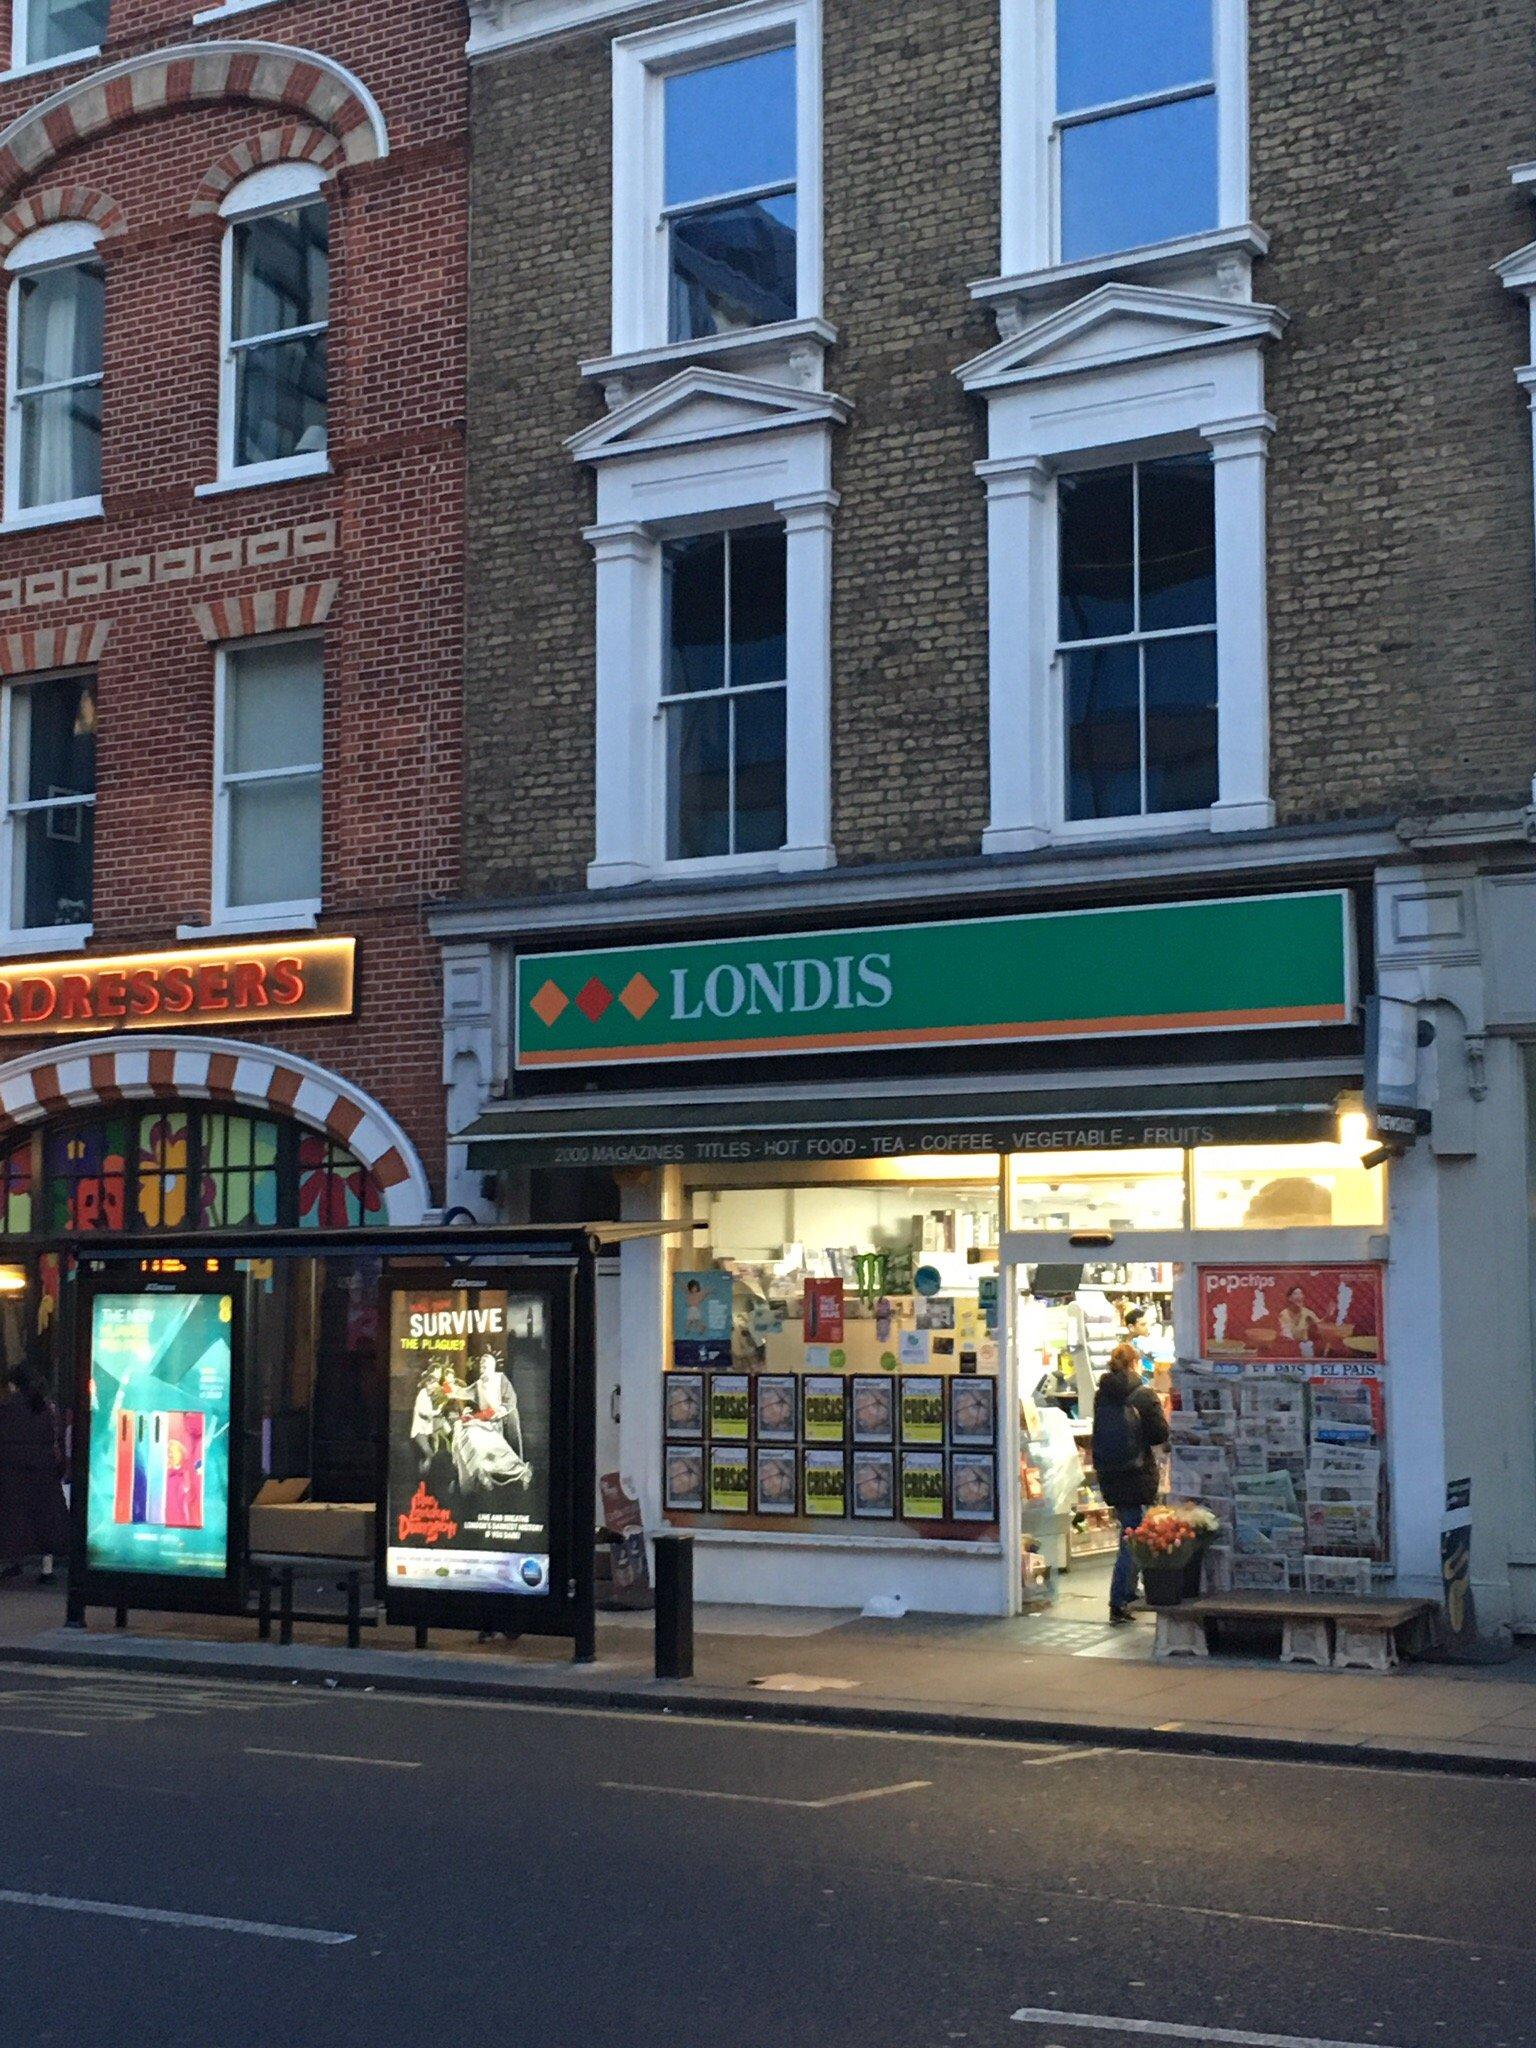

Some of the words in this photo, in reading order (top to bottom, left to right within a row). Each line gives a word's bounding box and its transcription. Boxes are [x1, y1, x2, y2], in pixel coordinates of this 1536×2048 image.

[670, 953, 893, 1020] LONDIS
[592, 1144, 685, 1162] MAGAZINES
[697, 1141, 751, 1158] TITLES
[765, 1139, 799, 1156] HOT
[807, 1138, 857, 1155] FOOD
[871, 1136, 905, 1152] TEA
[920, 1133, 993, 1150] COFFEE
[1012, 1129, 1122, 1149] VEGETABLE
[1143, 1126, 1214, 1144] FRUITS
[410, 1307, 503, 1338] SURVIVE
[400, 1337, 419, 1350] THE
[421, 1338, 466, 1351] PLAGUE?
[1321, 1363, 1342, 1376] EL
